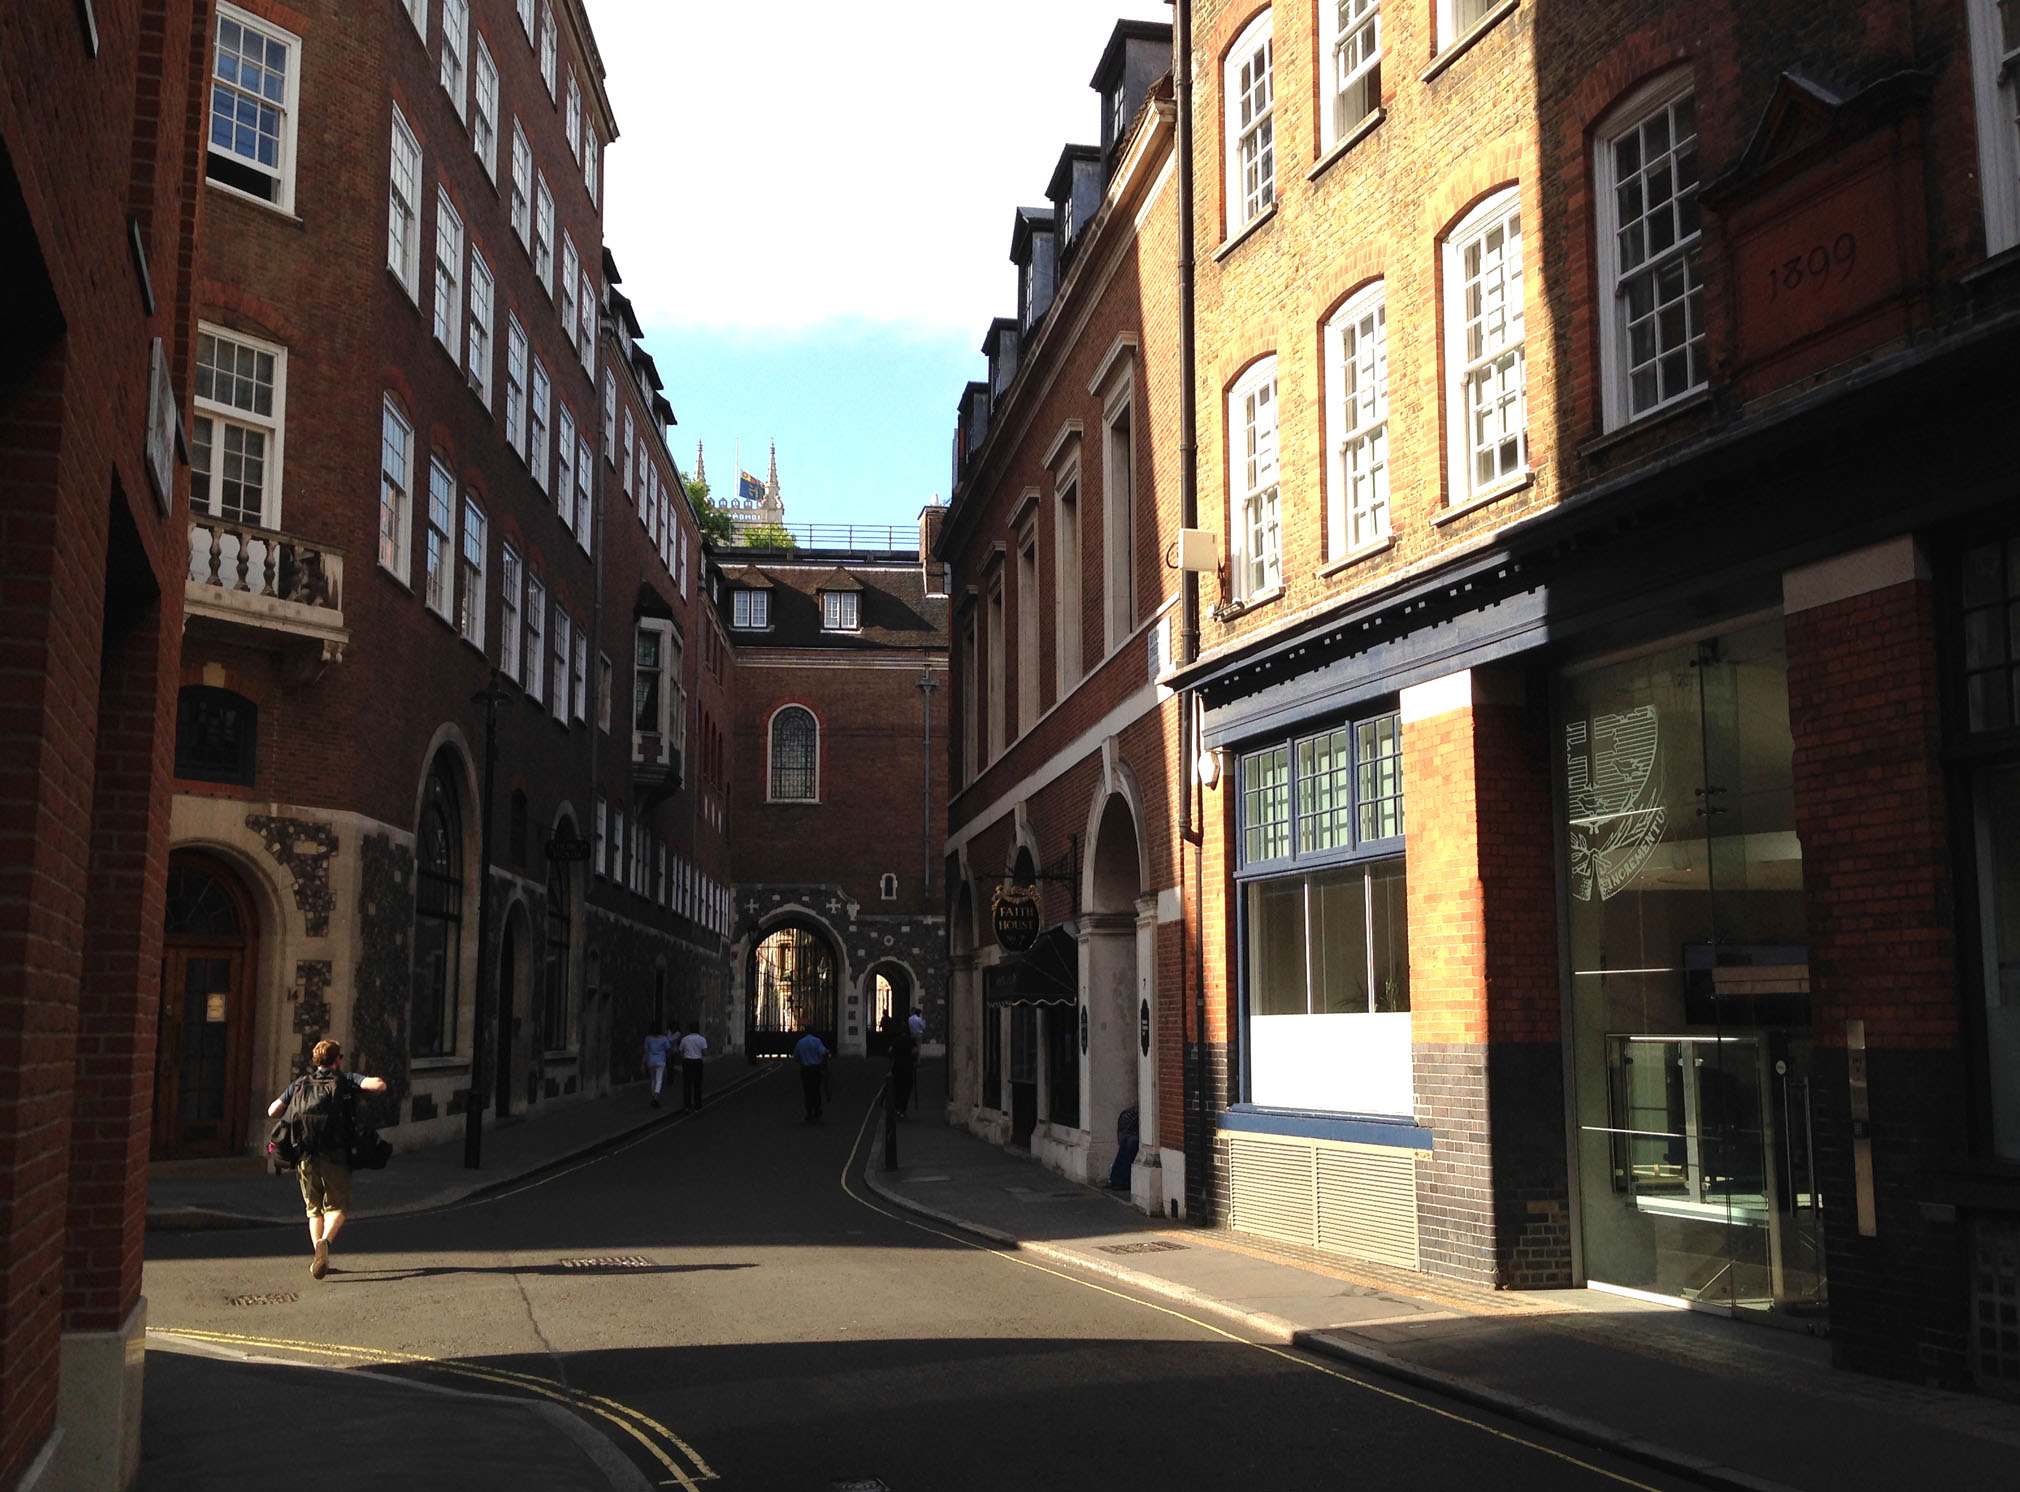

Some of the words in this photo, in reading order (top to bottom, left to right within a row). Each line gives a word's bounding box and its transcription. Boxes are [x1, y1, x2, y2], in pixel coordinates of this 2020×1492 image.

[1768, 233, 1856, 304] 1899
[999, 906, 1034, 917] FAITH
[999, 920, 1033, 931] HOUSE
